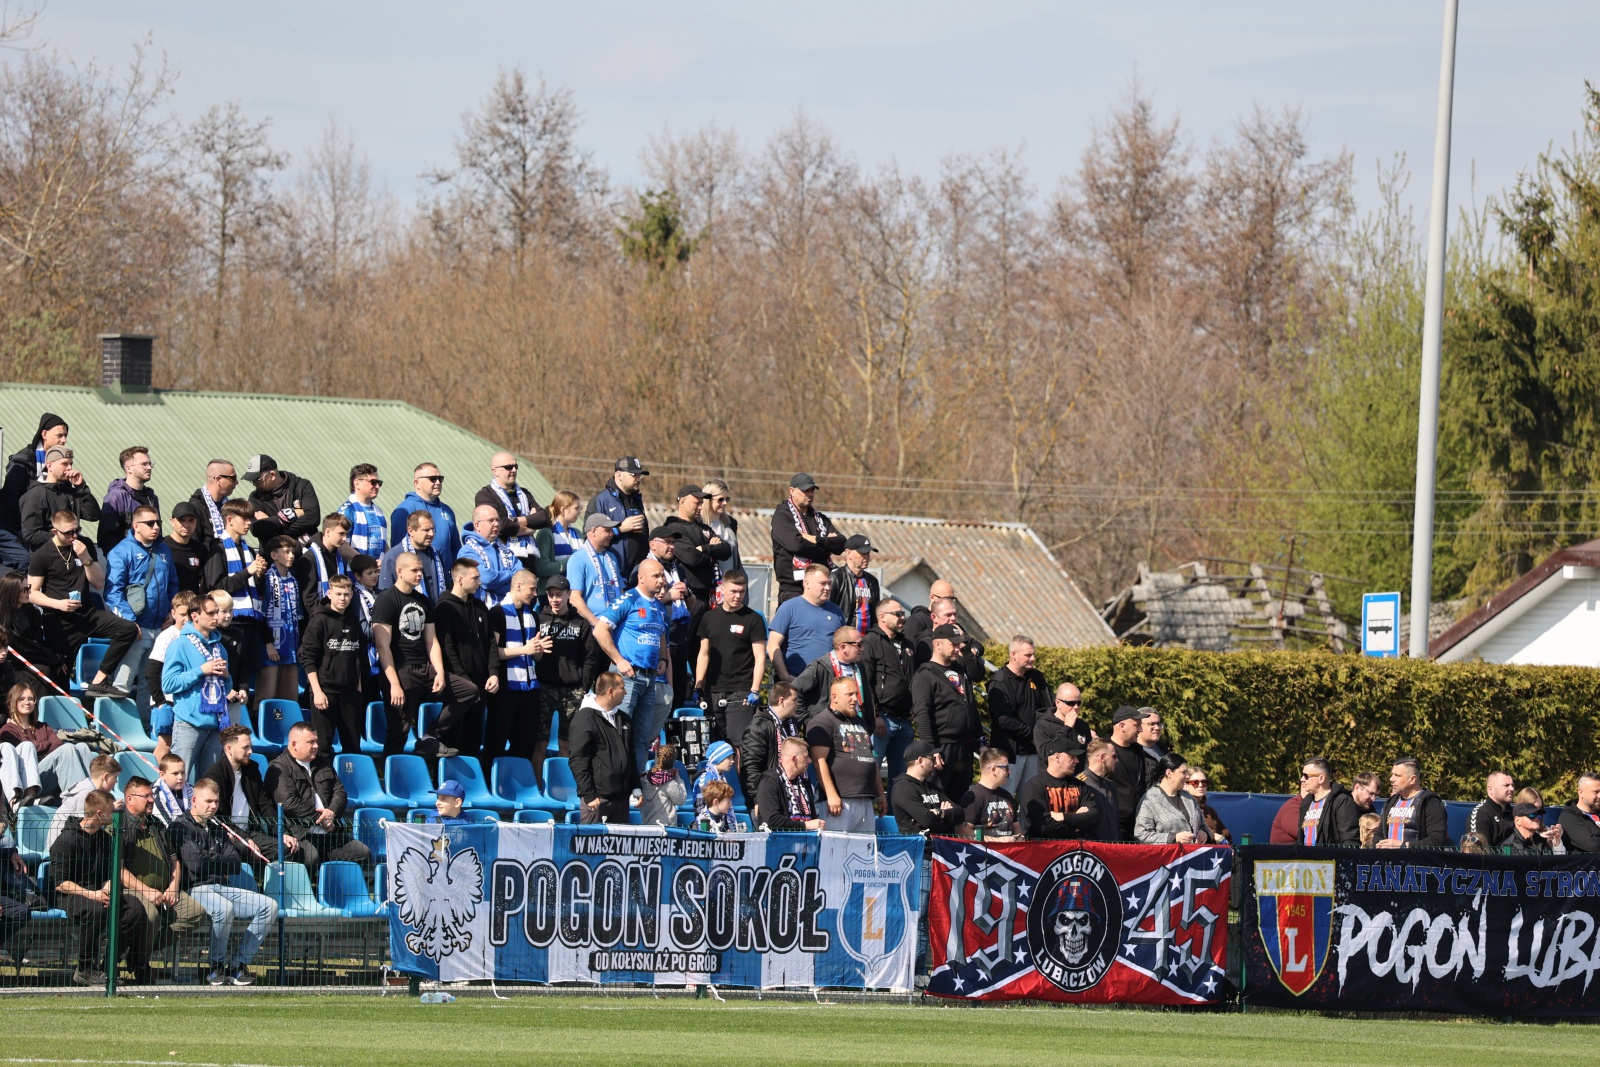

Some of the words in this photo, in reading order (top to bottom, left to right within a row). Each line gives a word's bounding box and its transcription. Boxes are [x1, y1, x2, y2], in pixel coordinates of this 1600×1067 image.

[575, 837, 585, 853] W
[587, 837, 632, 854] NASZYM
[634, 836, 676, 856] MIEŚCIE
[679, 840, 713, 858] JEDEN
[714, 841, 740, 860] KLUB
[1051, 853, 1106, 881] POGOŃ
[1262, 866, 1328, 891] POGOŃ
[1356, 864, 1518, 896] FANATYCZNA
[489, 855, 661, 948] POGOŃ
[671, 856, 829, 951] SOKÓŁ
[864, 897, 883, 939] L
[1285, 904, 1306, 917] 1945
[1285, 928, 1308, 972] L
[1327, 888, 1489, 998] POGOŃ
[595, 952, 609, 970] OD
[611, 952, 654, 970] KOŁYSKI
[655, 949, 669, 971] AŻ
[671, 953, 686, 971] PO
[688, 950, 717, 971] GRÓB
[1035, 947, 1106, 988] LUBACZÓW
